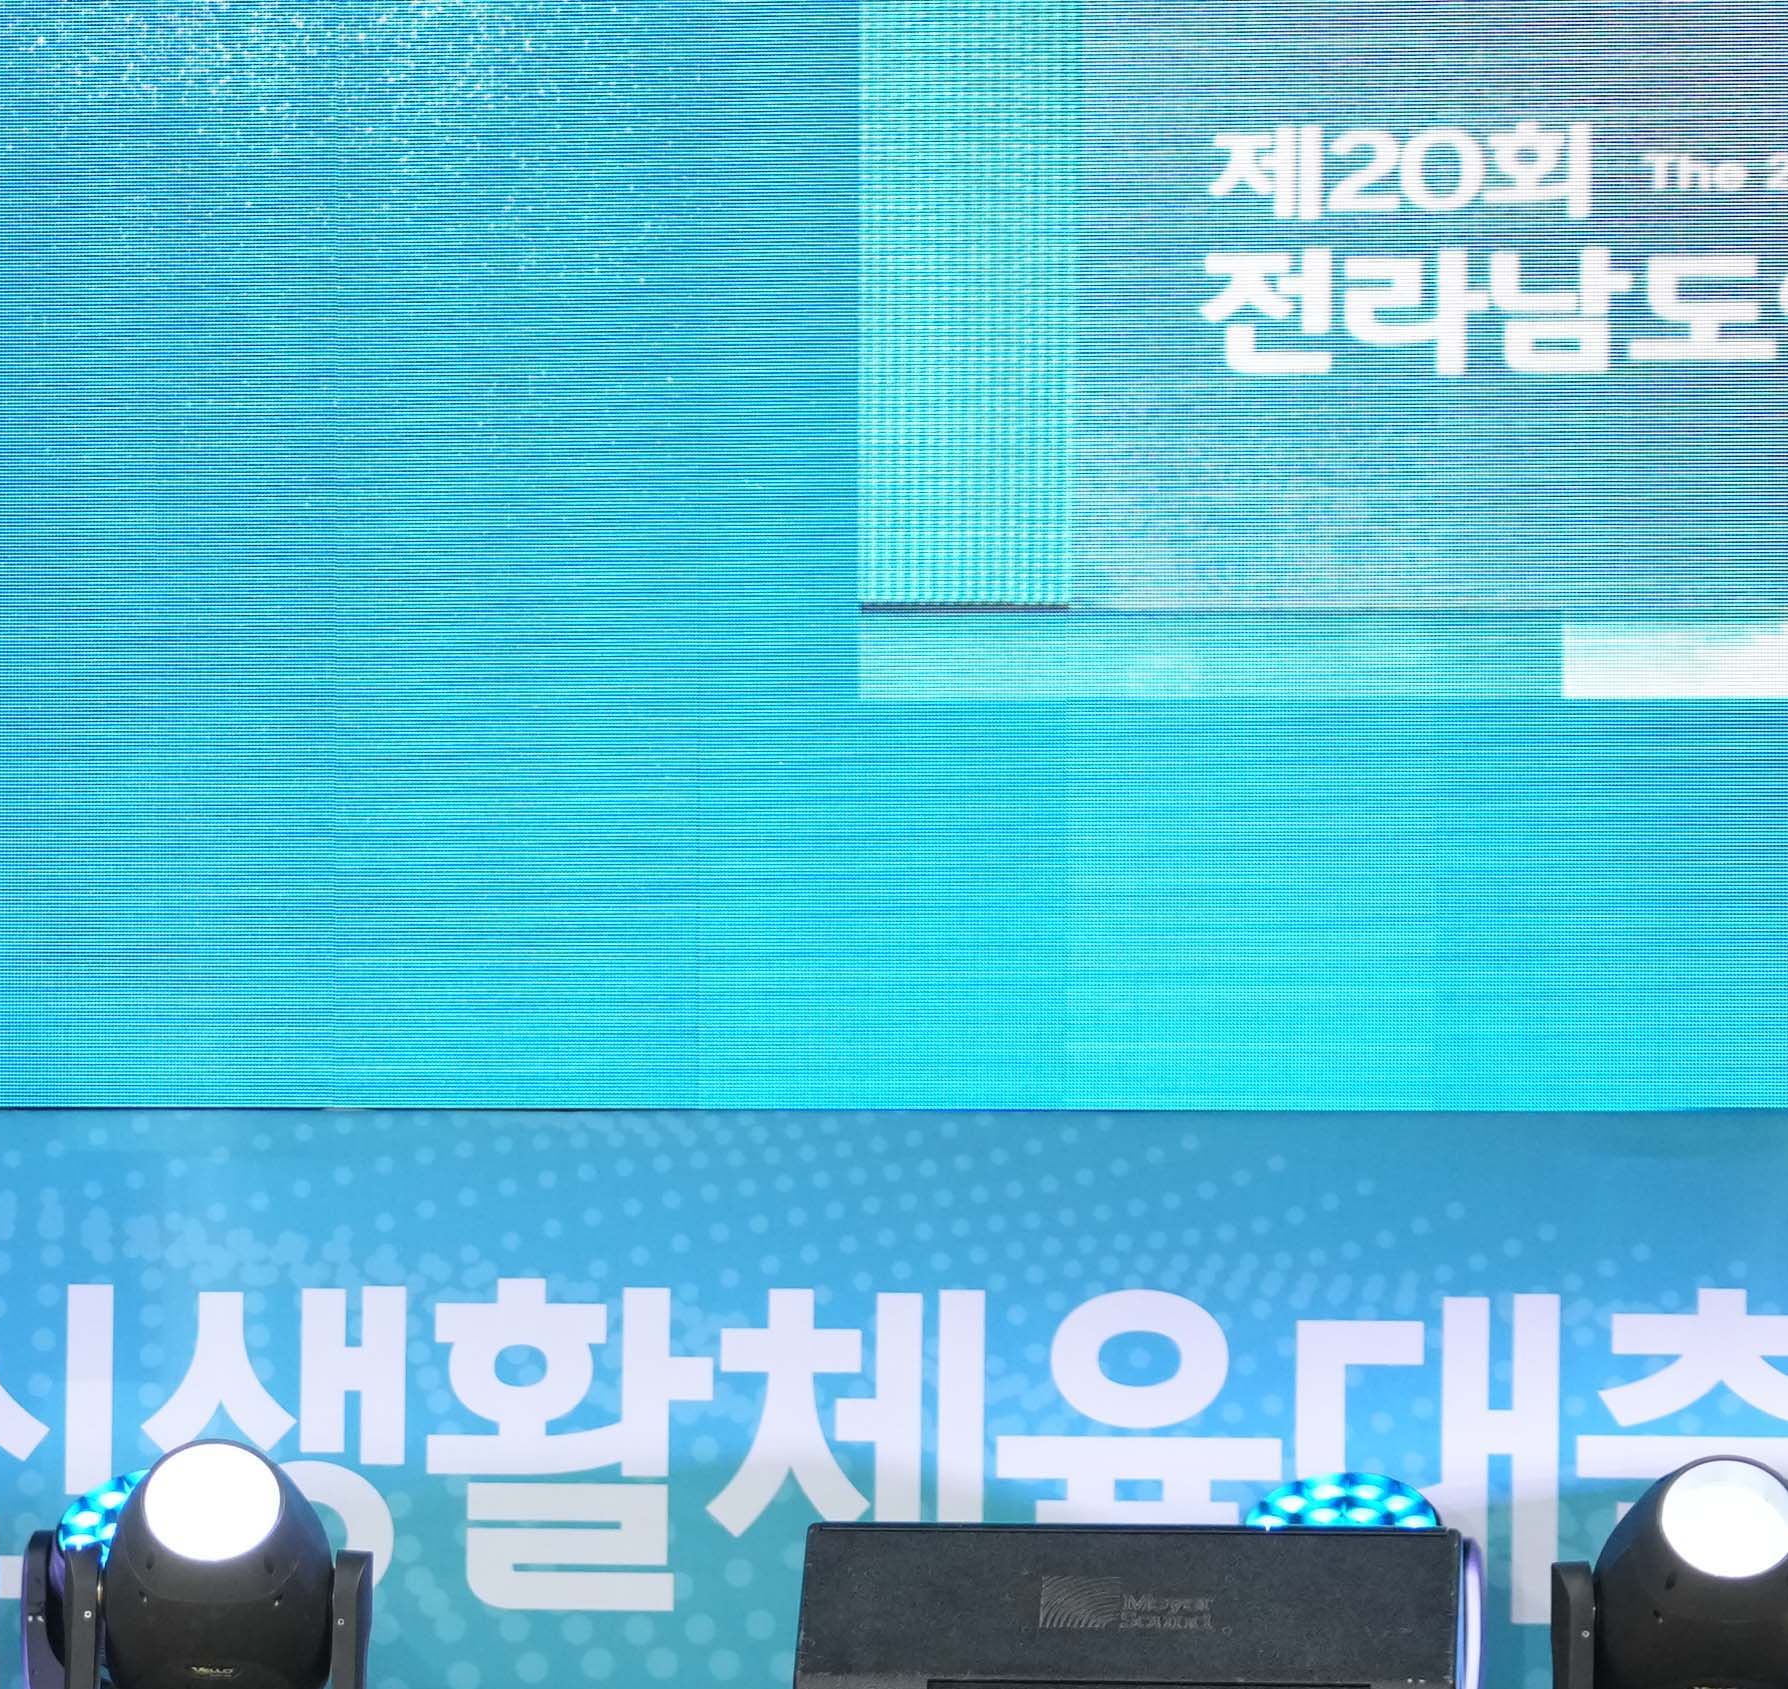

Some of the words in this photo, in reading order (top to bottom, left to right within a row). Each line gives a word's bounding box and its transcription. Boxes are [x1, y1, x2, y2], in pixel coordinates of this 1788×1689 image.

[1210, 121, 1592, 220] 제20회
[1644, 153, 1742, 190] The
[1201, 247, 1788, 376] 전라남도
